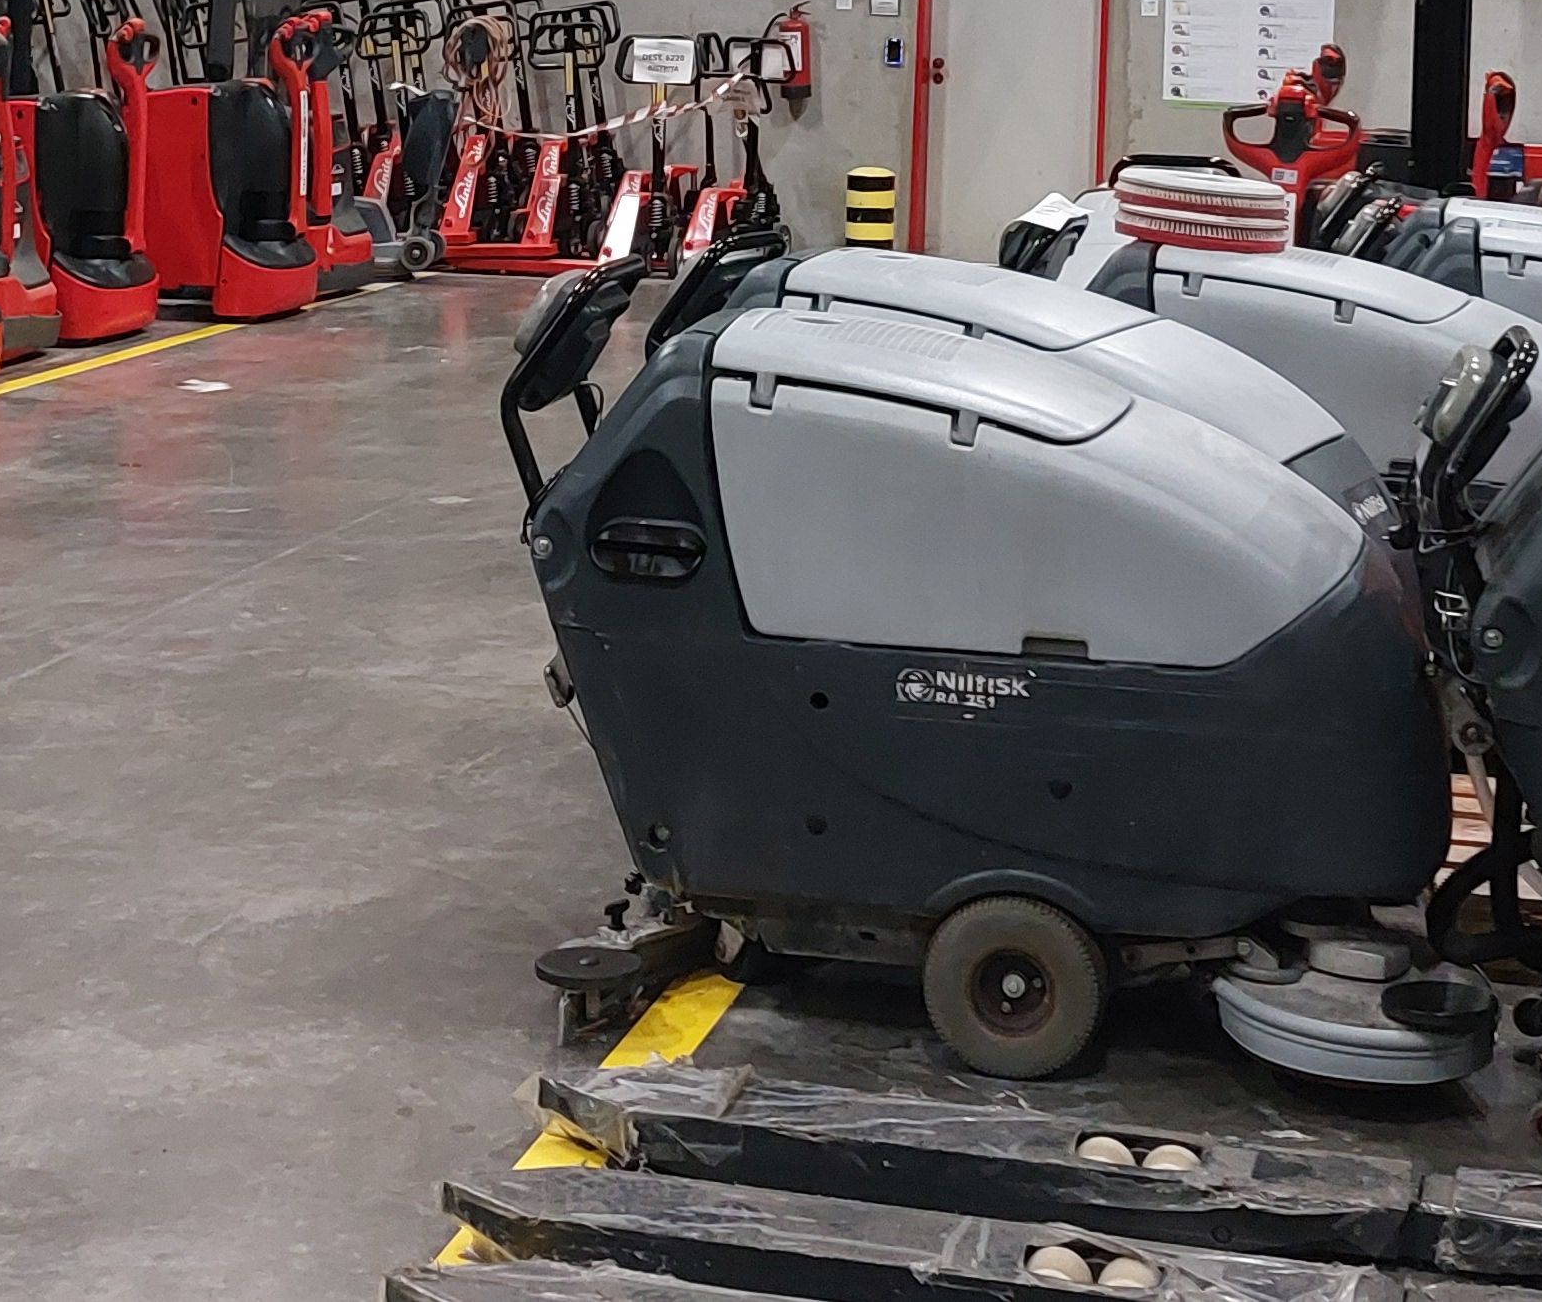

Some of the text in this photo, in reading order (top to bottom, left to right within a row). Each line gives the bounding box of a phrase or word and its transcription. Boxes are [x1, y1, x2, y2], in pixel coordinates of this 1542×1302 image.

[374, 157, 392, 196] Linde
[455, 171, 475, 219] Linde
[536, 185, 557, 234] Linde
